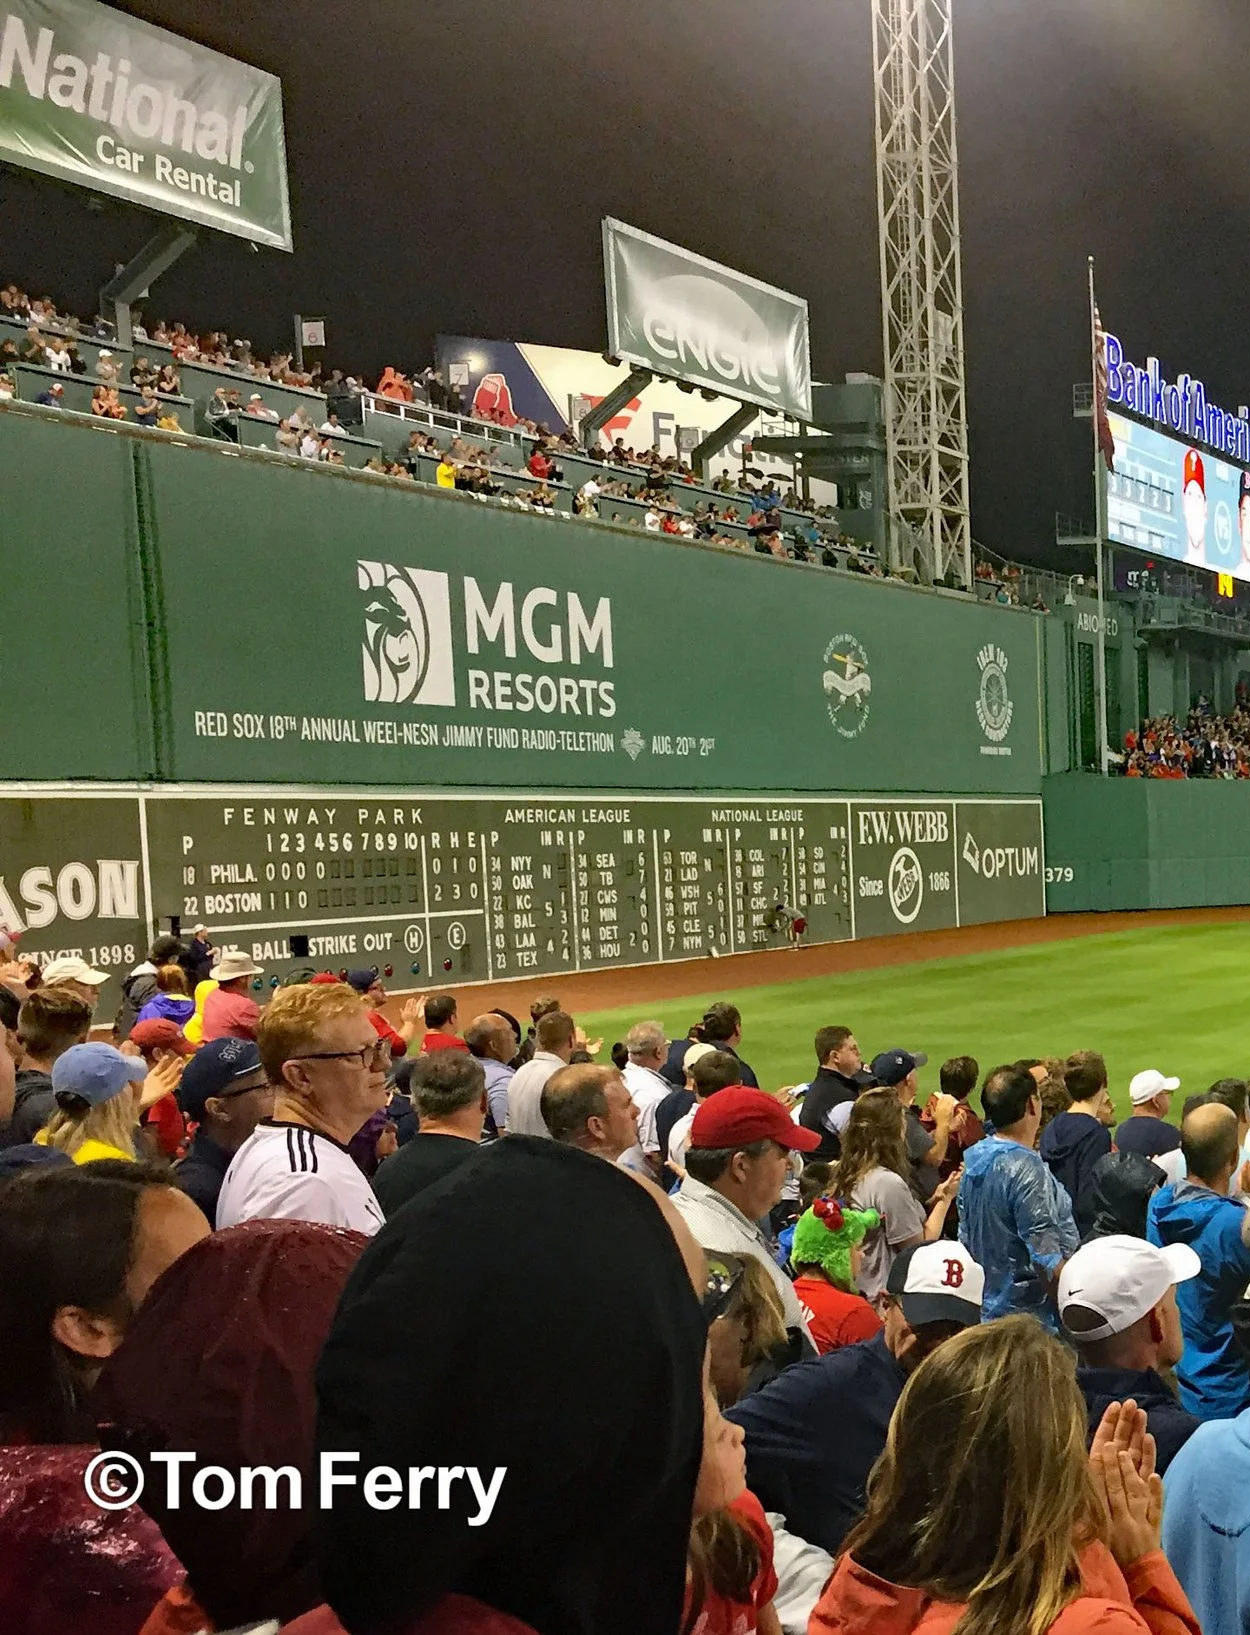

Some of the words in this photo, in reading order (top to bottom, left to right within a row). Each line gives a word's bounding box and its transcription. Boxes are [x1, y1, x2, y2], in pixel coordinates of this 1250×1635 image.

[96, 135, 145, 175] Car
[155, 153, 241, 208] Rental
[1101, 331, 1167, 426] Bank
[1165, 373, 1192, 435] of
[463, 576, 614, 668] MGM
[1077, 612, 1118, 636] ABIOED
[468, 669, 617, 718] RESORTS
[195, 712, 228, 737] RED
[233, 713, 265, 739] SOX
[301, 719, 360, 744] ANNUAL
[364, 721, 439, 747] WEEI-NESN
[442, 724, 484, 749] JIMMY
[486, 726, 520, 750] FUND
[522, 728, 615, 753] RADIO-TELETHON
[652, 735, 674, 755] AUG.
[224, 808, 337, 825] FENWAY
[359, 809, 423, 825] PARK
[505, 809, 576, 824] AMERICAN
[582, 809, 631, 823] LEAGUE
[712, 810, 762, 822] NATIONAL
[766, 810, 803, 822] LEAGUE
[858, 811, 893, 844] F.W.
[895, 811, 948, 843] WEBB
[183, 836, 193, 855] P
[404, 832, 418, 851] 10
[432, 832, 440, 848] R
[451, 832, 459, 848] H
[468, 831, 475, 848] E
[491, 831, 499, 847] P
[541, 830, 552, 846] IN
[557, 830, 564, 846] R
[578, 830, 585, 845] P
[638, 829, 645, 844] R
[511, 856, 532, 871] NYY
[596, 854, 615, 868] SEA
[680, 852, 698, 865] TOR
[750, 850, 764, 862] COL
[982, 847, 1038, 878] OPTUM
[183, 866, 195, 885] 18
[211, 864, 258, 884] PHILA.
[266, 863, 275, 881] 0
[281, 863, 290, 881] 0
[296, 863, 305, 880] 0
[316, 862, 325, 880] 0
[433, 858, 441, 874] 0
[469, 857, 477, 873] 0
[543, 864, 551, 880] N
[681, 867, 698, 881] LAD
[1045, 868, 1074, 883] 379
[513, 875, 534, 890] OAK
[600, 872, 613, 886] TB
[859, 877, 883, 897] Since
[929, 872, 950, 891] 1866
[681, 885, 699, 898] WSH
[753, 882, 763, 895] SF
[184, 897, 198, 916] 22
[205, 893, 262, 915] BOSTON
[299, 891, 307, 909] 0
[435, 885, 442, 902] 2
[453, 885, 460, 900] 3
[470, 884, 477, 900] 0
[516, 895, 532, 910] KC
[597, 890, 618, 904] CWS
[751, 897, 768, 910] CHC
[600, 908, 617, 922] MIN
[684, 902, 697, 915] PIT
[514, 913, 536, 929] BAL
[684, 919, 700, 933] CLE
[516, 933, 536, 948] LAA
[600, 927, 618, 941] DET
[253, 940, 291, 962] BALL
[308, 935, 356, 956] STRIKE
[364, 932, 392, 951] OUT
[684, 936, 702, 950] NYM
[90, 943, 135, 967] 1898
[600, 944, 620, 959] HOU
[517, 952, 537, 968] TEX
[941, 1258, 964, 1288] B
